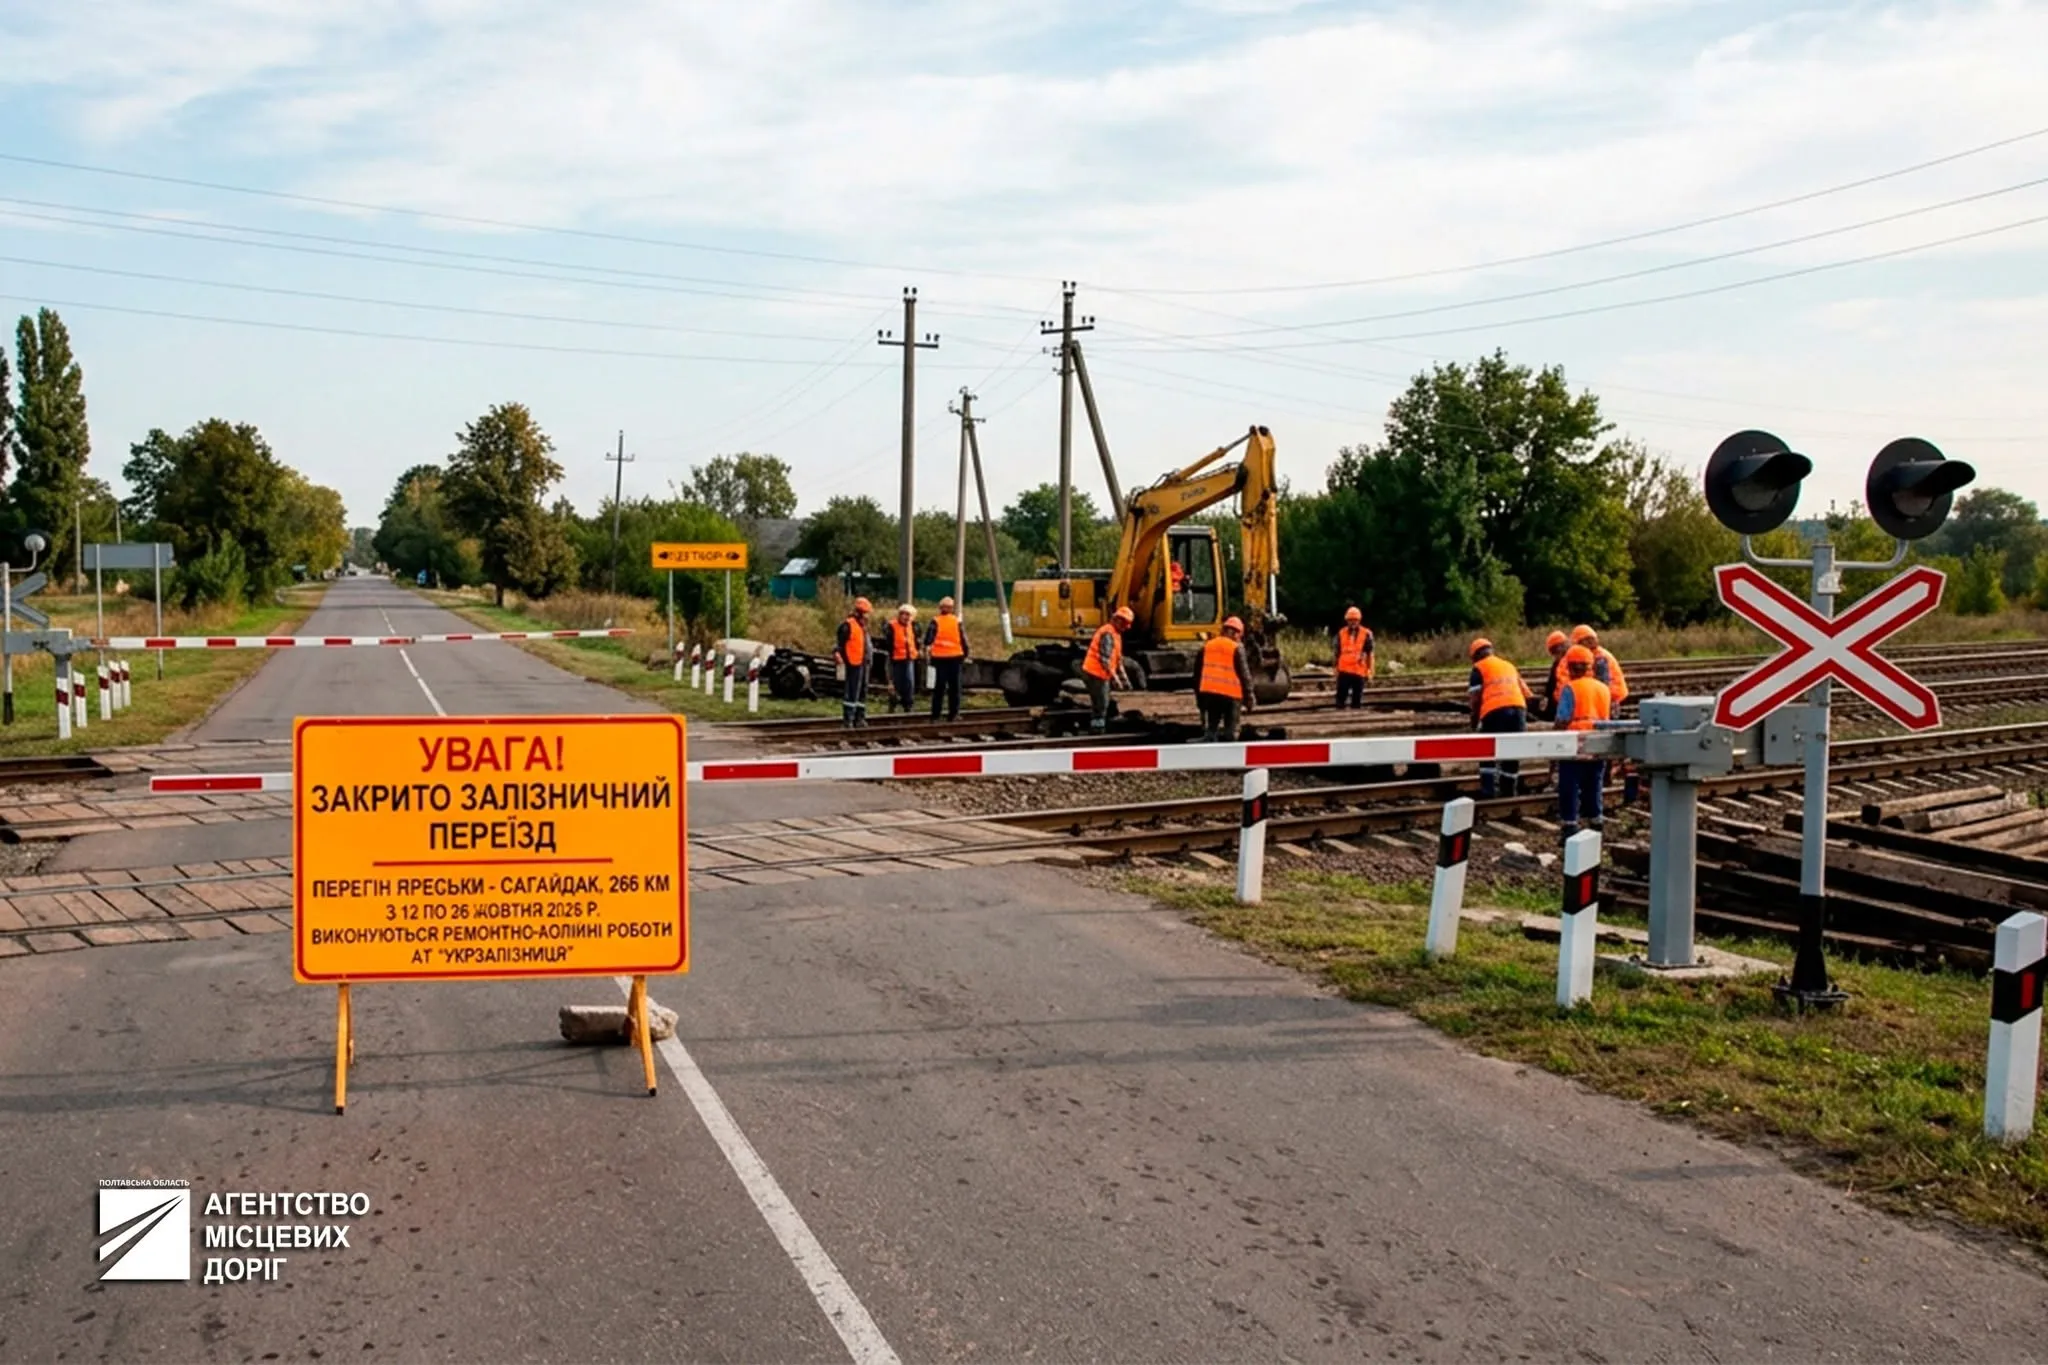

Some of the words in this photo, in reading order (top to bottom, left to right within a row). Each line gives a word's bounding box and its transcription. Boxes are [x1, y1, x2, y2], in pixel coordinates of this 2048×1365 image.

[418, 735, 564, 773] УВАГА!
[311, 784, 452, 813] ЗАКРИТО
[460, 776, 671, 811] ЗАЛІЗНИЧНИЙ
[429, 815, 557, 853] ПЕРЕЇЗД
[312, 879, 392, 898] ПЕРЕГІН
[397, 878, 485, 897] ЯРЕСЬКИ
[500, 873, 604, 897] САГАЙДАК,
[609, 875, 640, 894] 266
[644, 874, 670, 892] КМ
[402, 904, 419, 920] 12
[423, 903, 448, 920] ПО
[451, 903, 470, 919] 26
[311, 926, 439, 945] ВИКОНУЮТЬСЯ
[608, 922, 673, 939] РОБОТИ
[412, 948, 433, 964] АТ
